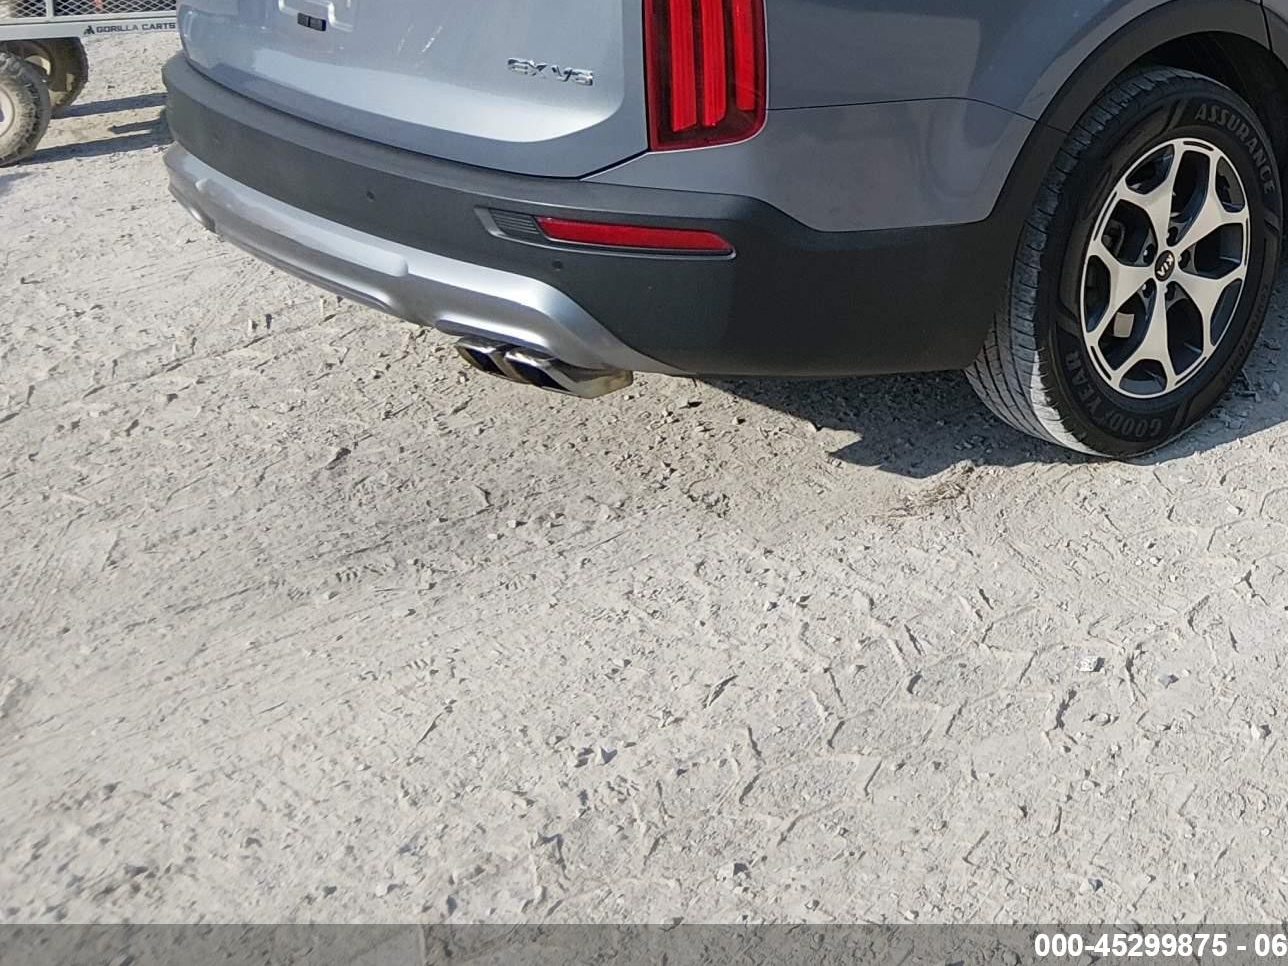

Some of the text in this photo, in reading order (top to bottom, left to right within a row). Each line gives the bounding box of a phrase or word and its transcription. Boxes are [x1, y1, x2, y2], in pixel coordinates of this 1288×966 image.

[96, 22, 176, 33] GORILLA CARTS
[507, 57, 594, 87] EX V6
[1195, 103, 1276, 194] ASSURANCE
[1065, 350, 1163, 438] GOODYEAR
